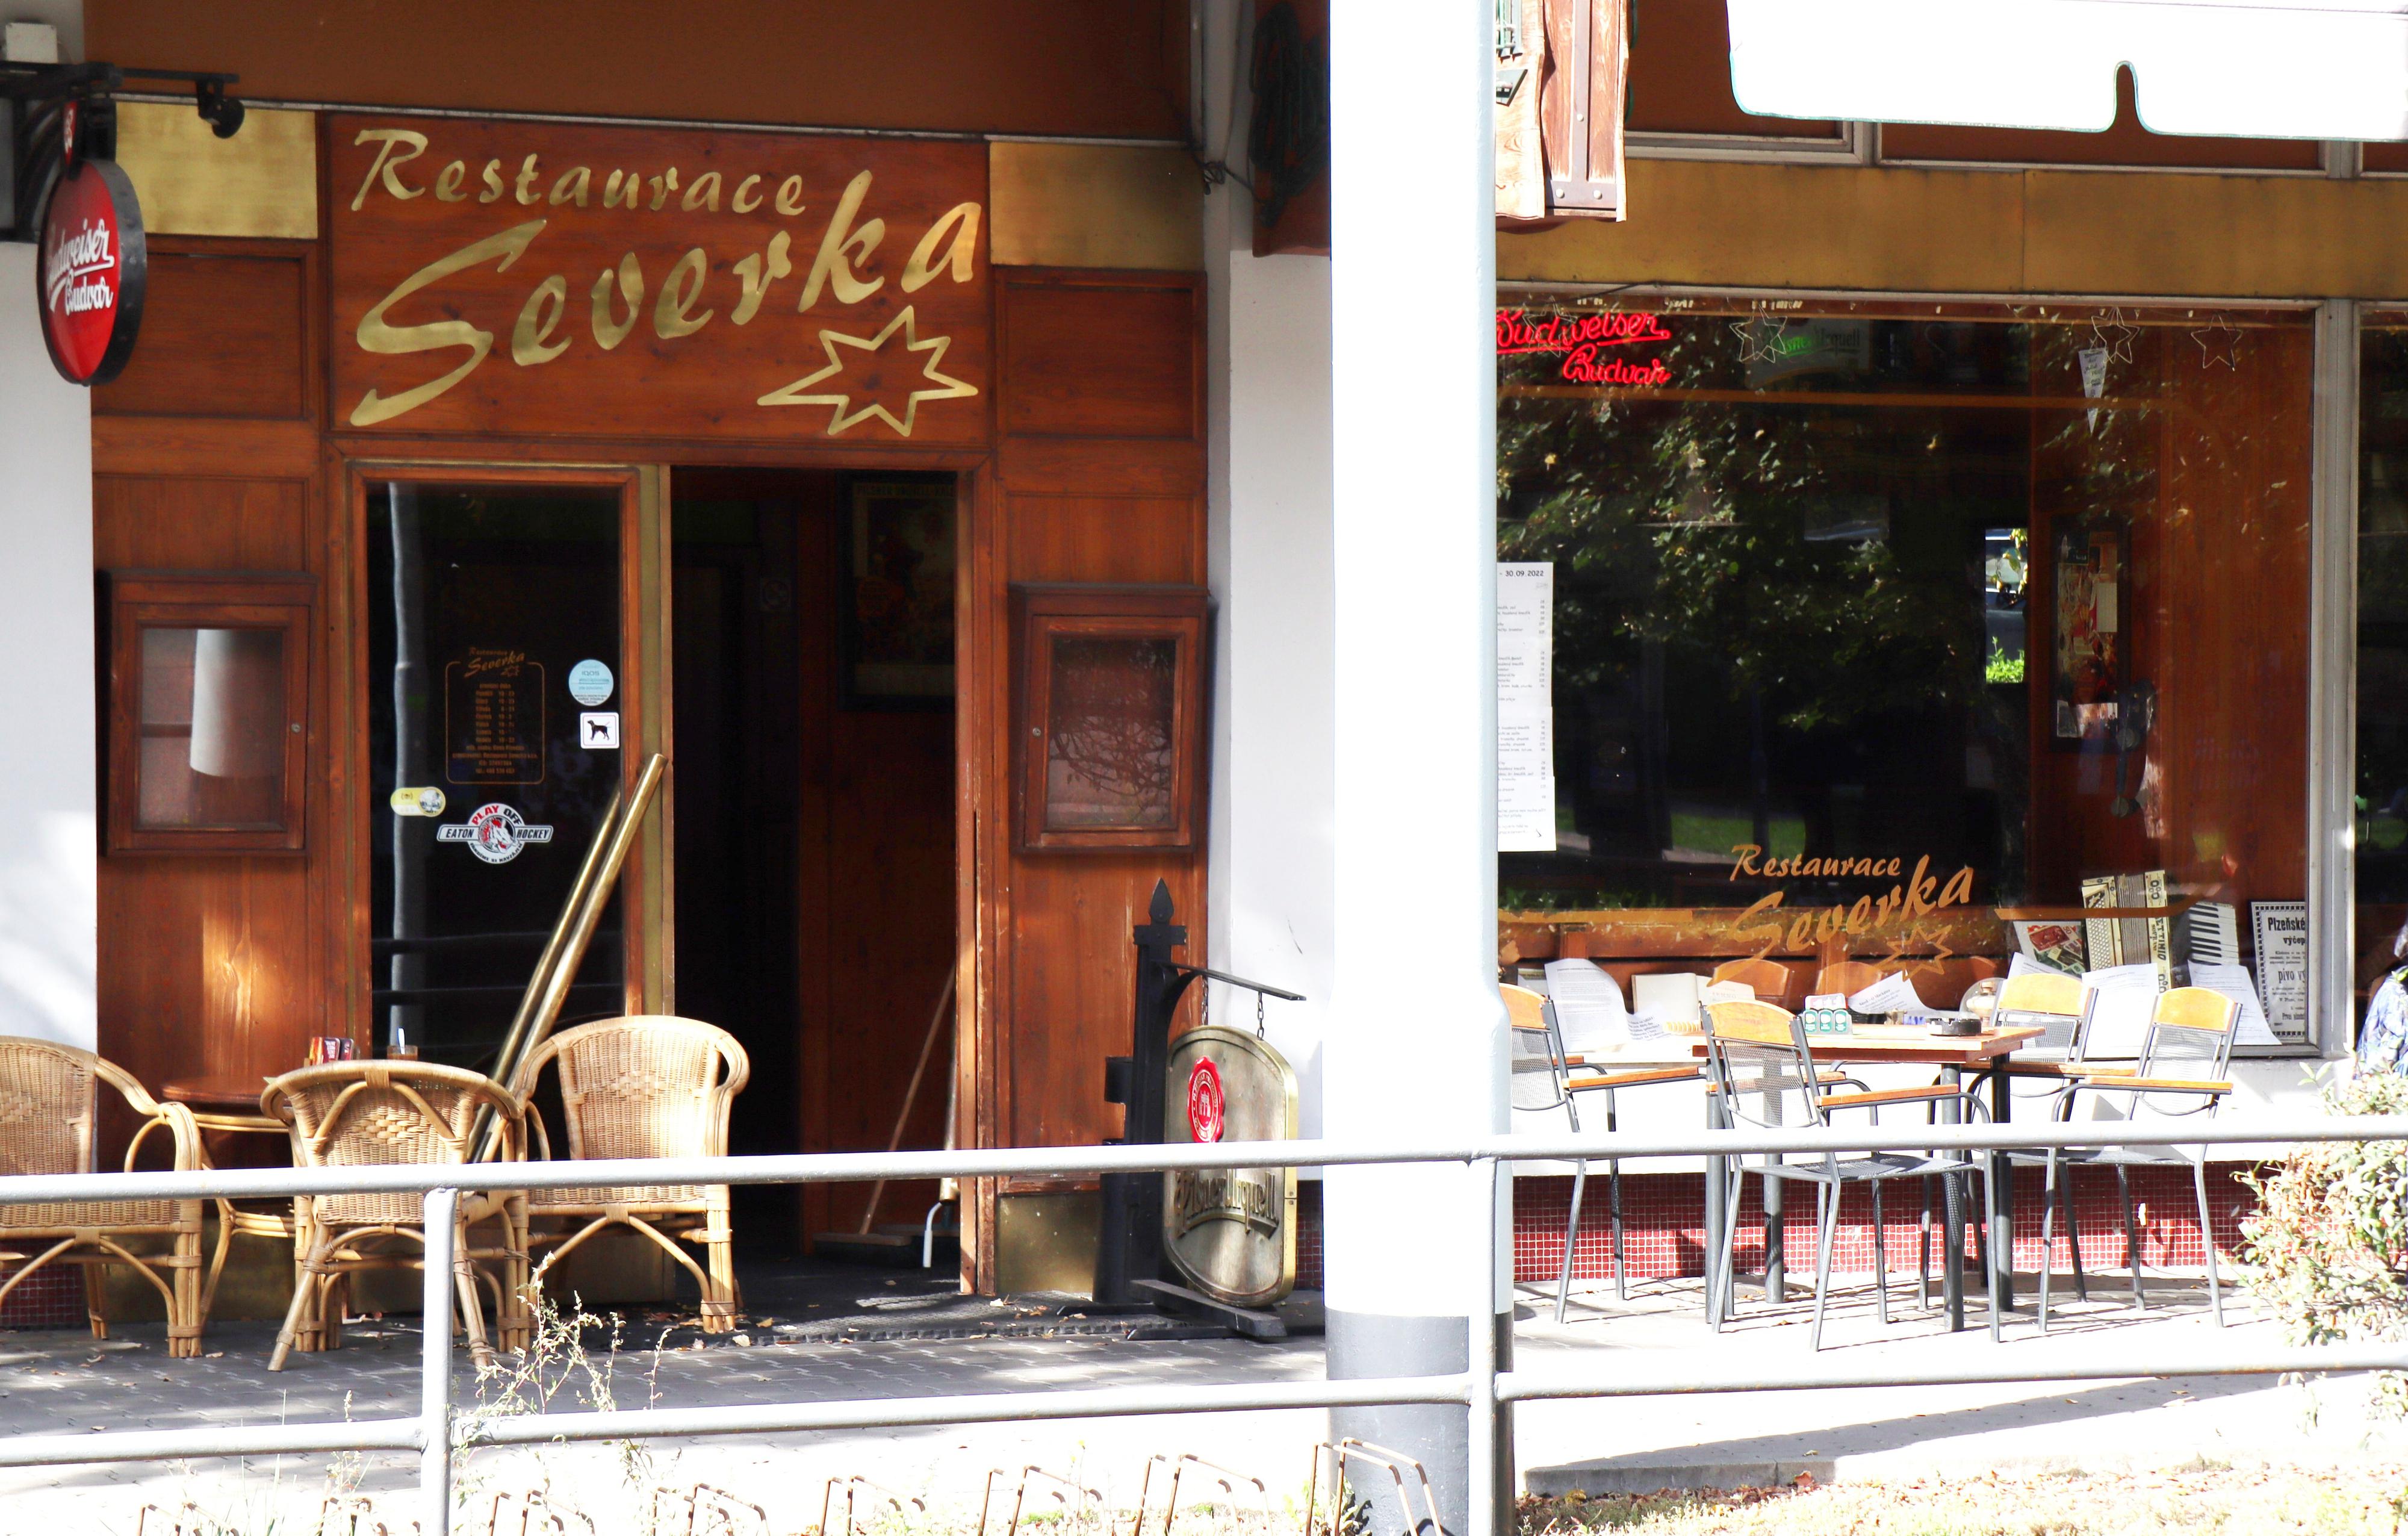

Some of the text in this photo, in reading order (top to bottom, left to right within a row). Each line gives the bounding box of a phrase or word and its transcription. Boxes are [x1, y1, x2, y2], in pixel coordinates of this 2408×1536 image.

[351, 128, 806, 216] Restaurace
[64, 269, 114, 316] Budvar
[350, 169, 982, 427] Severka
[1562, 343, 1672, 385] Budvar
[464, 650, 525, 678] Severka
[445, 828, 474, 838] EATON
[471, 804, 522, 826] PLAY OFF
[517, 829, 549, 839] HOCKEY
[1730, 844, 1901, 882] Restaurace
[1707, 854, 1975, 987] Severka
[2155, 917, 2167, 961] ETTIMIO
[2268, 917, 2306, 931] Plzeňské
[2278, 968, 2295, 984] pivo
